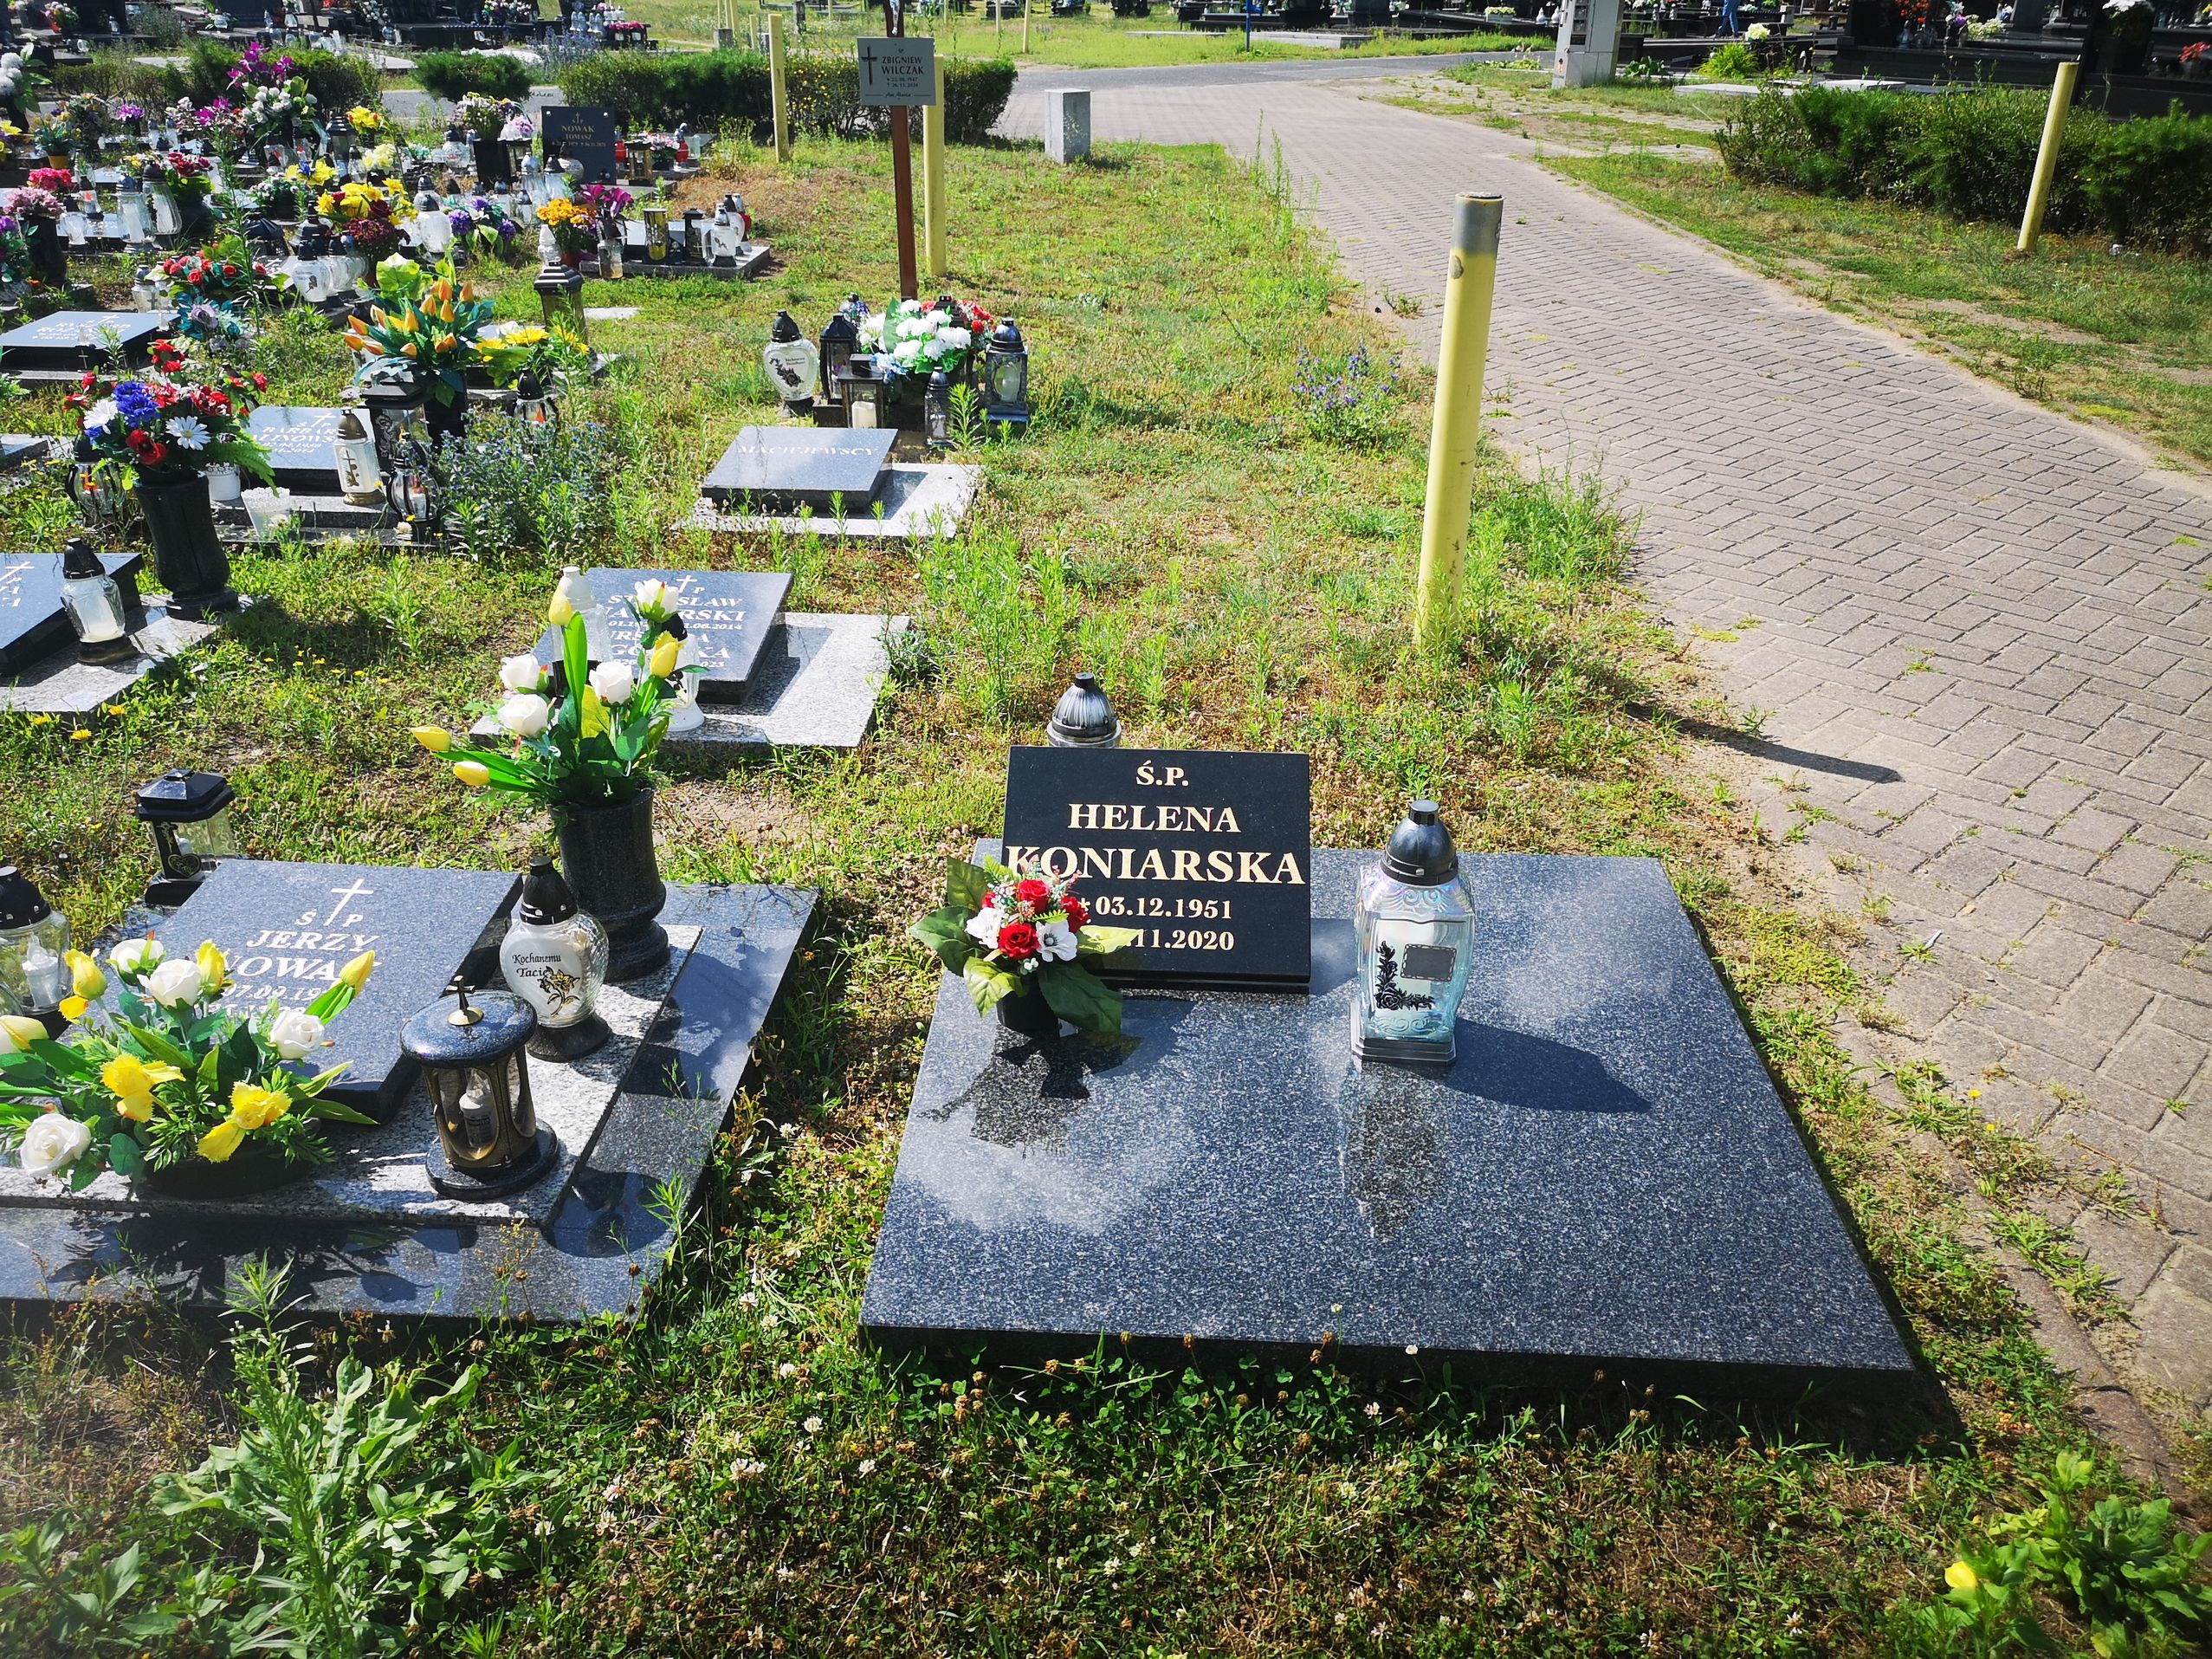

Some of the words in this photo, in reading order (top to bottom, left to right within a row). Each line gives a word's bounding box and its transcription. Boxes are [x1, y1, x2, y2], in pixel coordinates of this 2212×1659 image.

[882, 55, 922, 64] ZBIGNIEW
[881, 65, 924, 75] WILCZAK
[738, 445, 878, 457] MACIEJEWSCY
[694, 586, 706, 594] P
[1135, 760, 1189, 787] Ś.P.
[1067, 803, 1241, 833] HELENA
[1005, 846, 1306, 885] KONIARSKA
[1095, 896, 1232, 919] 03.12.1951
[342, 914, 364, 927] P
[246, 930, 381, 952] JERZY
[1126, 929, 1234, 951] .11.2020
[512, 953, 562, 965] Kochanemu
[223, 955, 383, 982] OWA
[516, 967, 548, 978] Tacie
